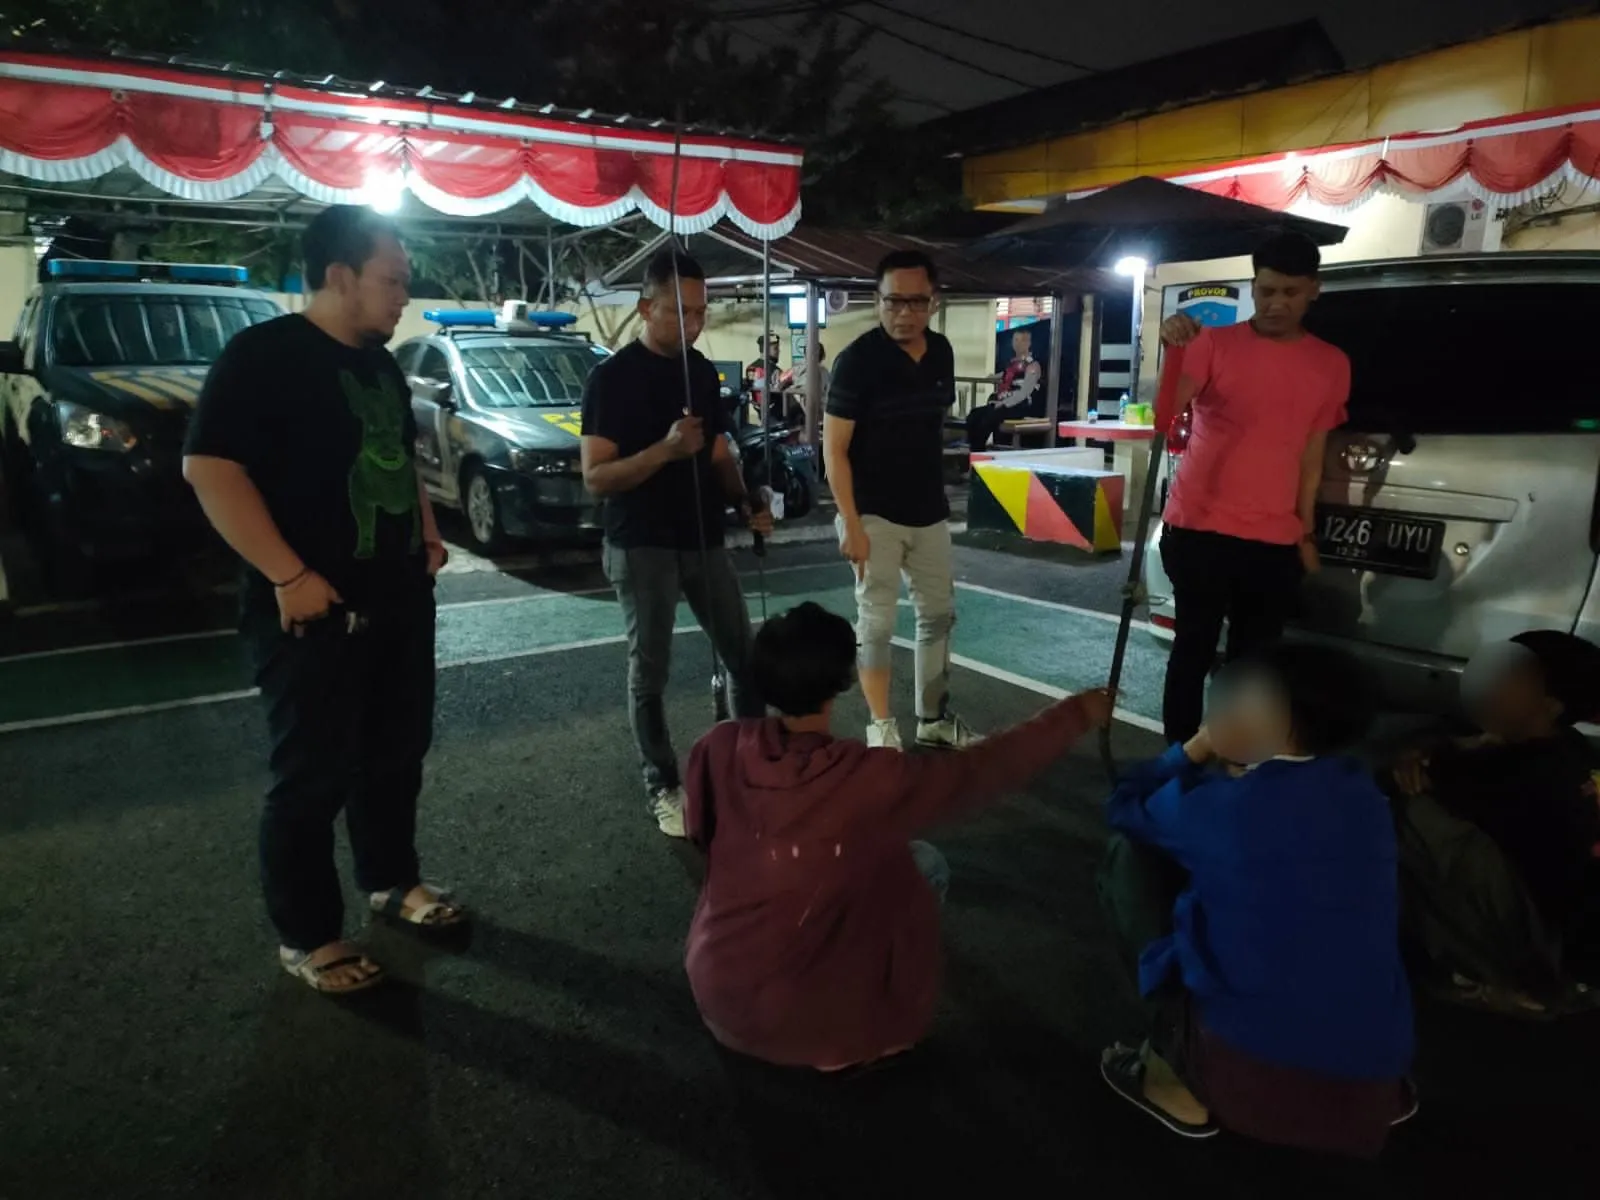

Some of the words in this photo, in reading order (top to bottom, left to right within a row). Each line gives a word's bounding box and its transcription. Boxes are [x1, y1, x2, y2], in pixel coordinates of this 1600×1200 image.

[1187, 287, 1228, 299] PROVOS
[1324, 515, 1373, 545] 1246
[1387, 523, 1432, 553] UYU
